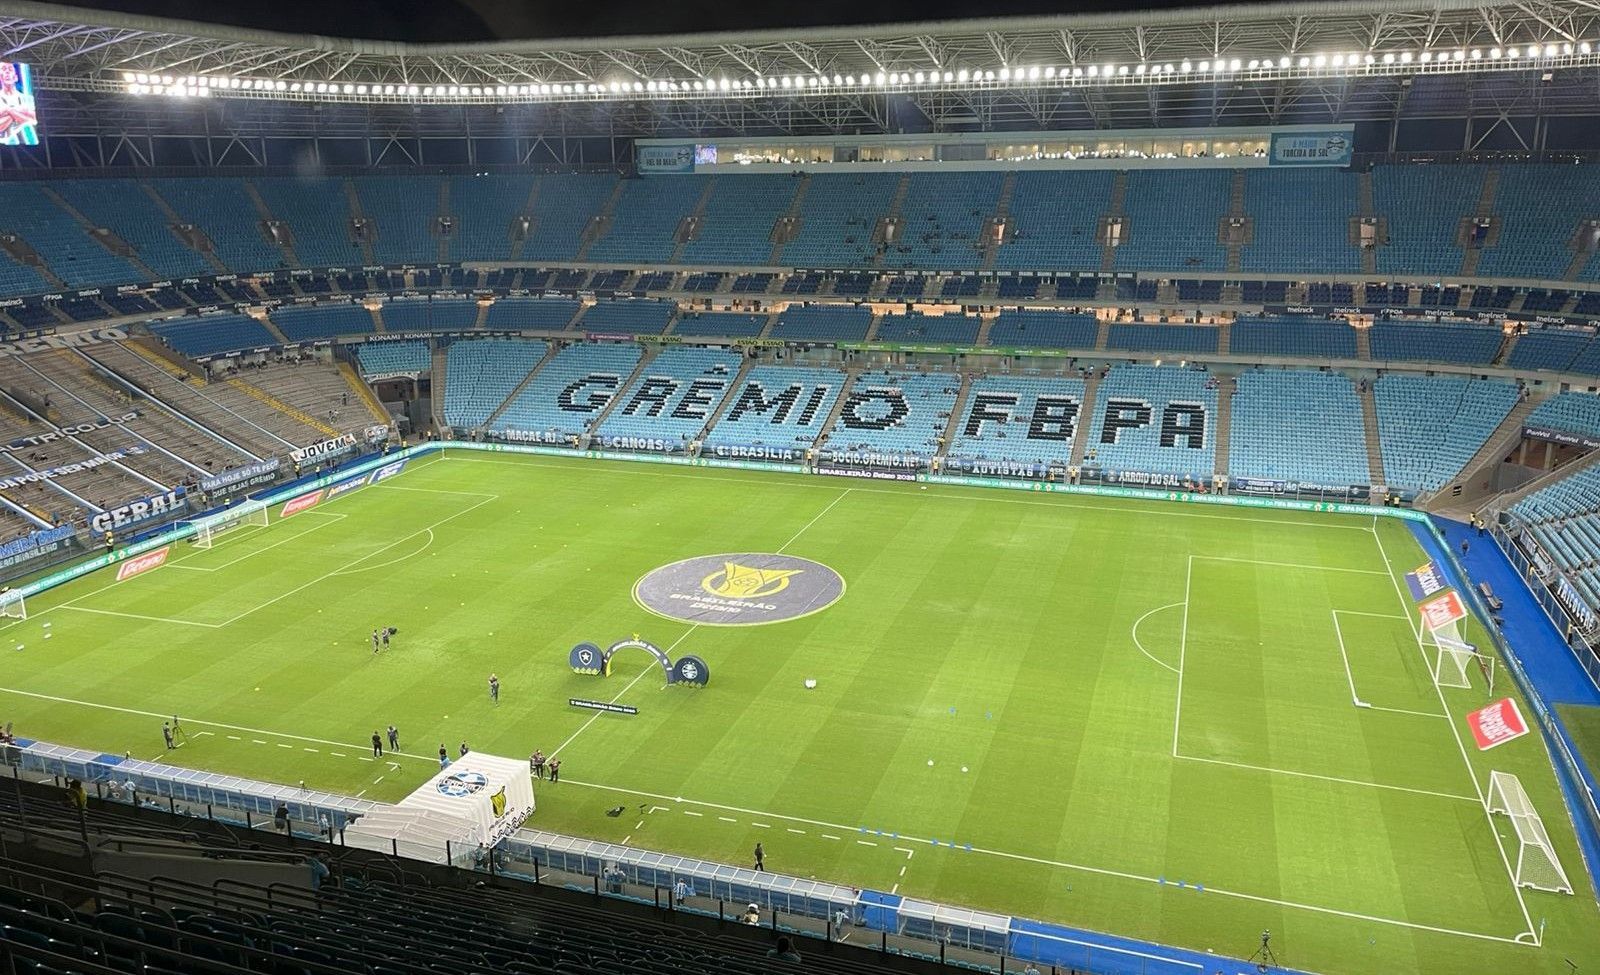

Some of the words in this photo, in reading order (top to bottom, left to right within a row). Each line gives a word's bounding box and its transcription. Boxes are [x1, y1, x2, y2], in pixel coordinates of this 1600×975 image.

[1334, 306, 1361, 314] melnick
[1425, 308, 1456, 316] melnick
[1478, 311, 1508, 319] melnick
[1536, 315, 1567, 324] melnick
[24, 411, 138, 446] TRICOLOR
[963, 392, 1209, 449] FBPA
[300, 437, 345, 461] JOVEM
[612, 436, 664, 451] CANOAS
[972, 466, 1034, 477] AUTISTAS
[1150, 472, 1162, 485] DO
[1162, 474, 1180, 486] SAL
[92, 492, 185, 533] GERAL
